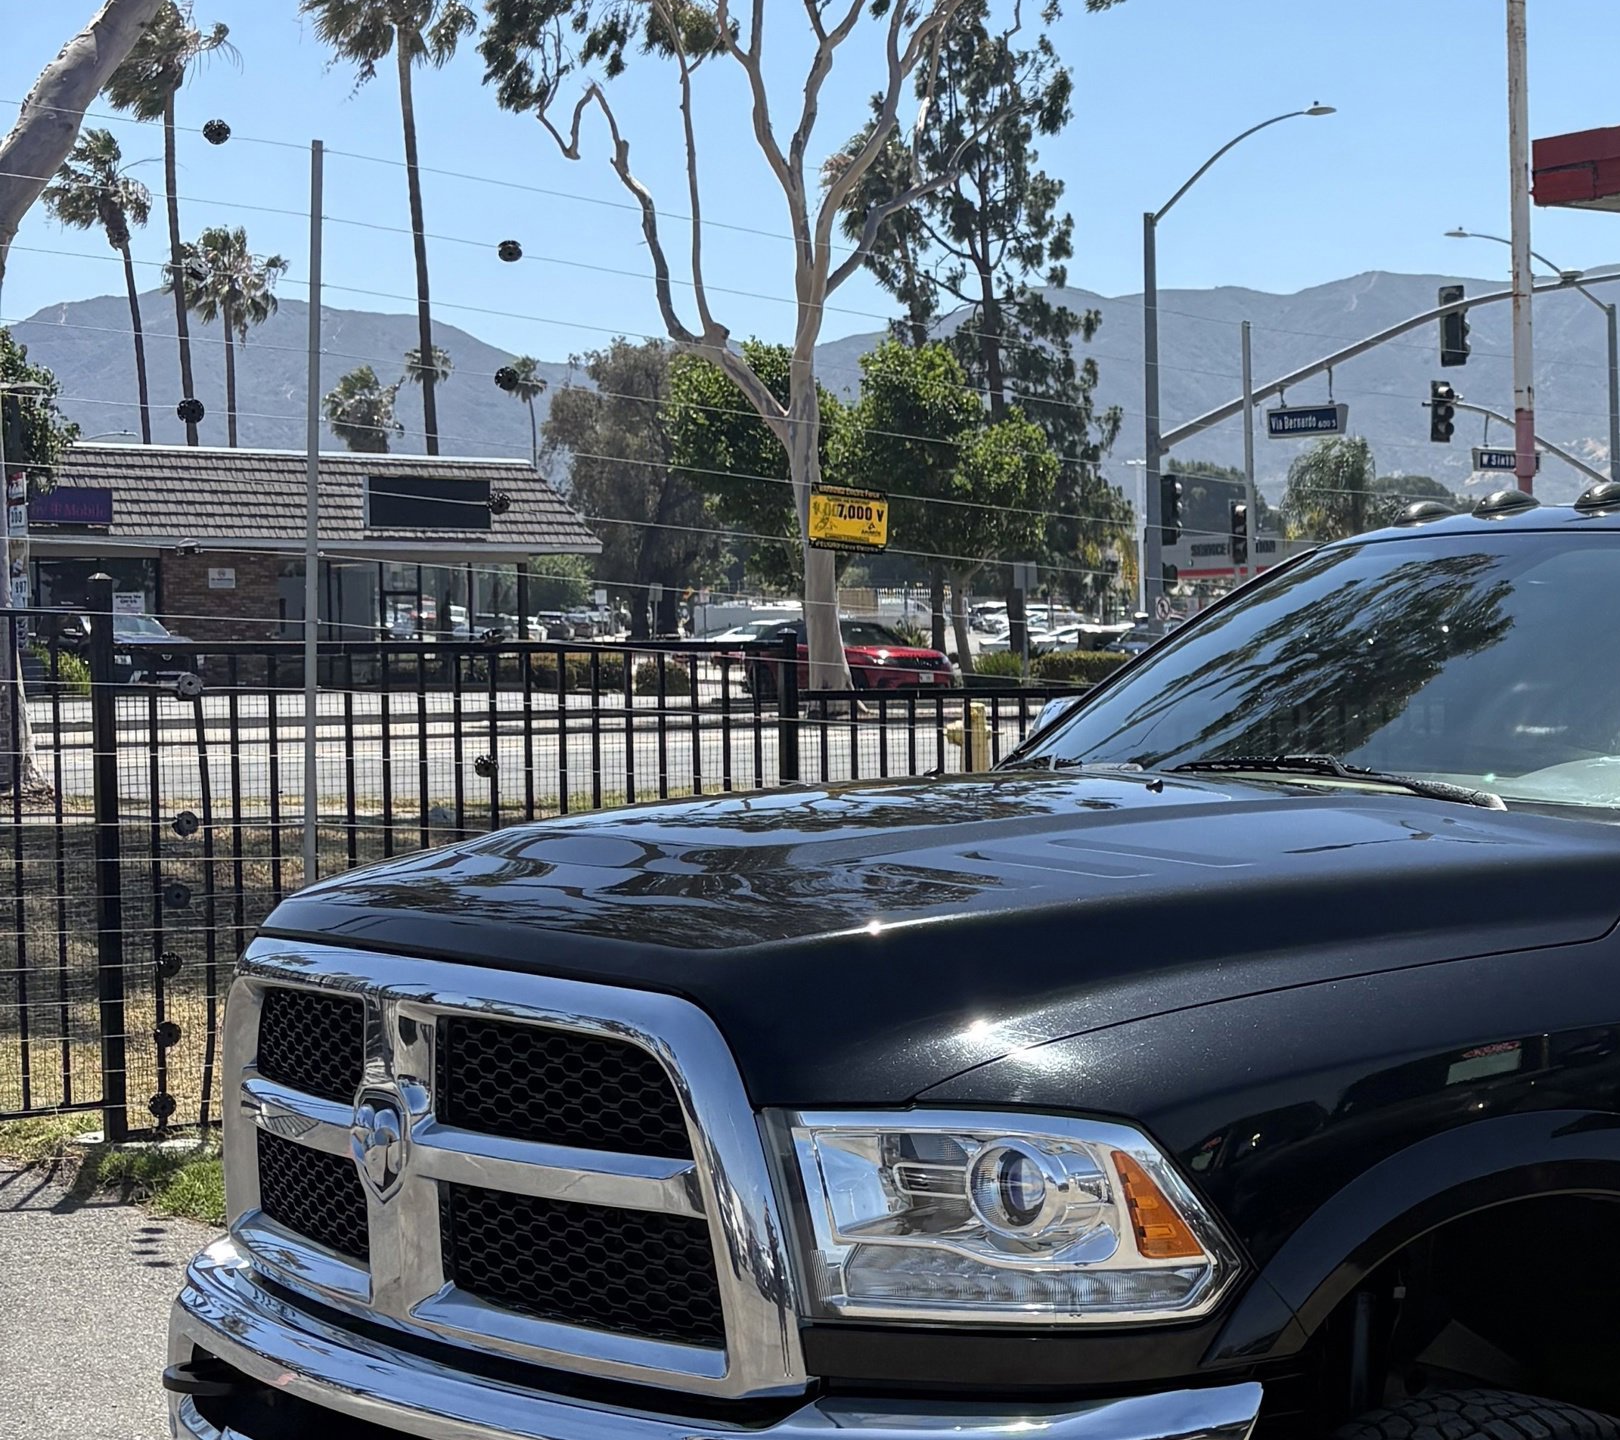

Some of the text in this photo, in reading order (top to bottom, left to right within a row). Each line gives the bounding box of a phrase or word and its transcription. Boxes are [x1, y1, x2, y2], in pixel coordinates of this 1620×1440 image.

[1271, 416, 1283, 431] Via
[1482, 454, 1489, 465] W
[837, 503, 873, 521] 7,000
[876, 509, 884, 522] V
